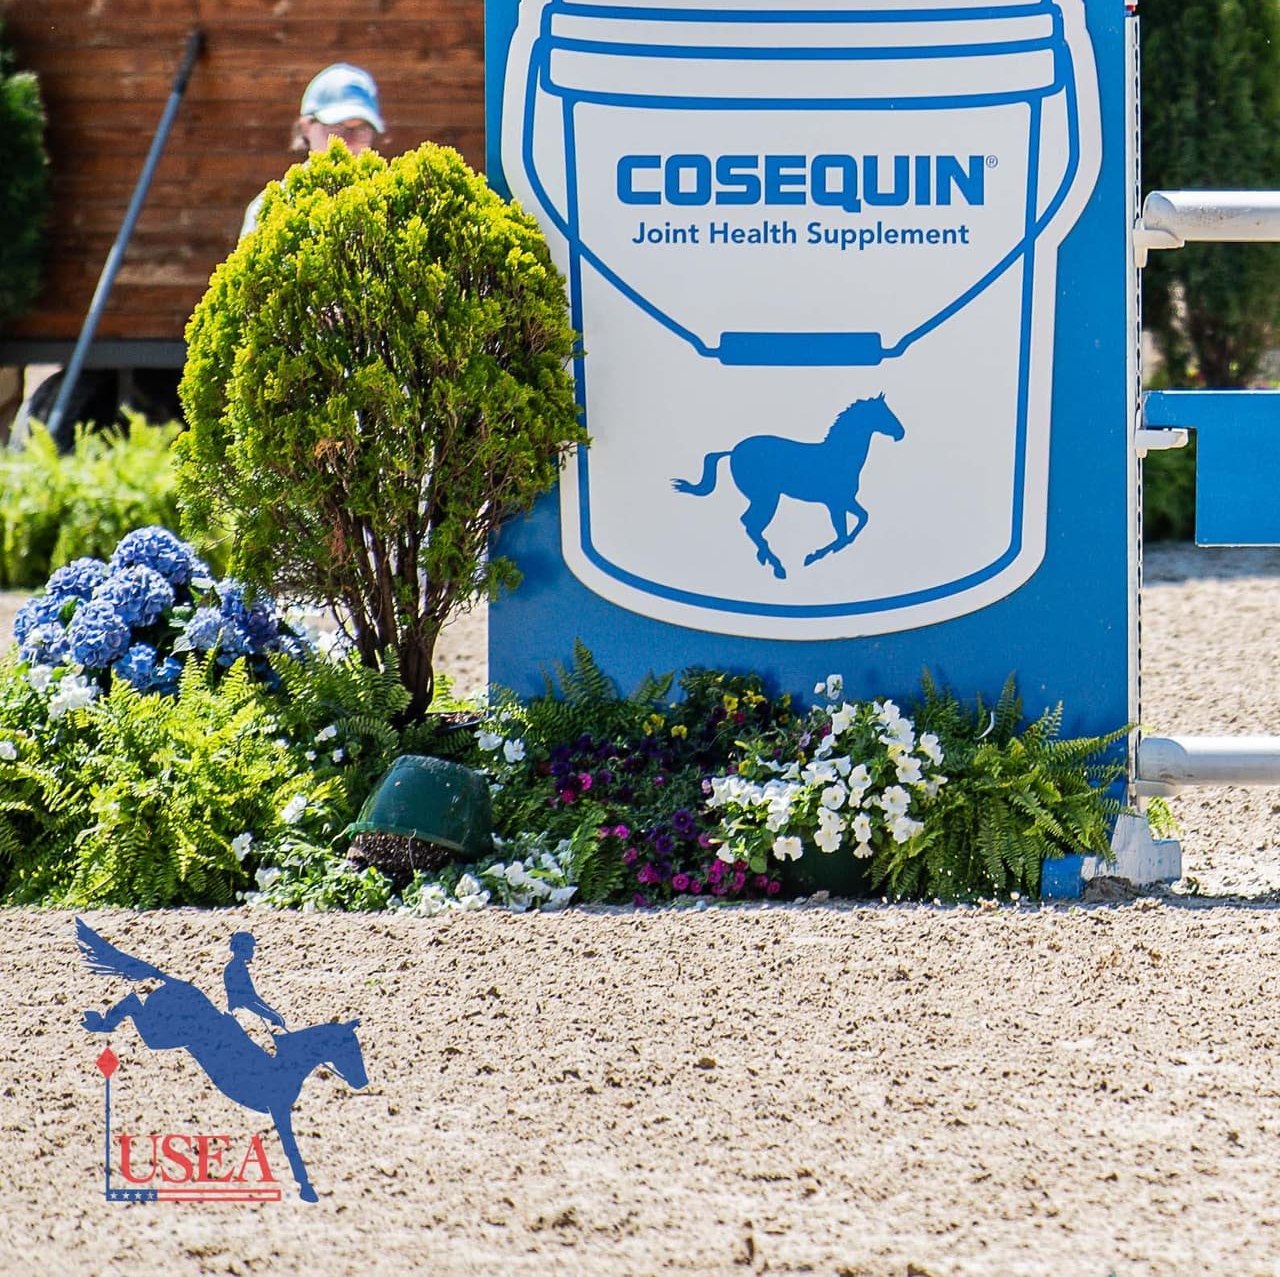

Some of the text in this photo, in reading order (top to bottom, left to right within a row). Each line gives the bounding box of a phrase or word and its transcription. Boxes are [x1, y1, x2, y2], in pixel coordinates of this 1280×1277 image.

[632, 220, 970, 250] Joint Health Supplement
